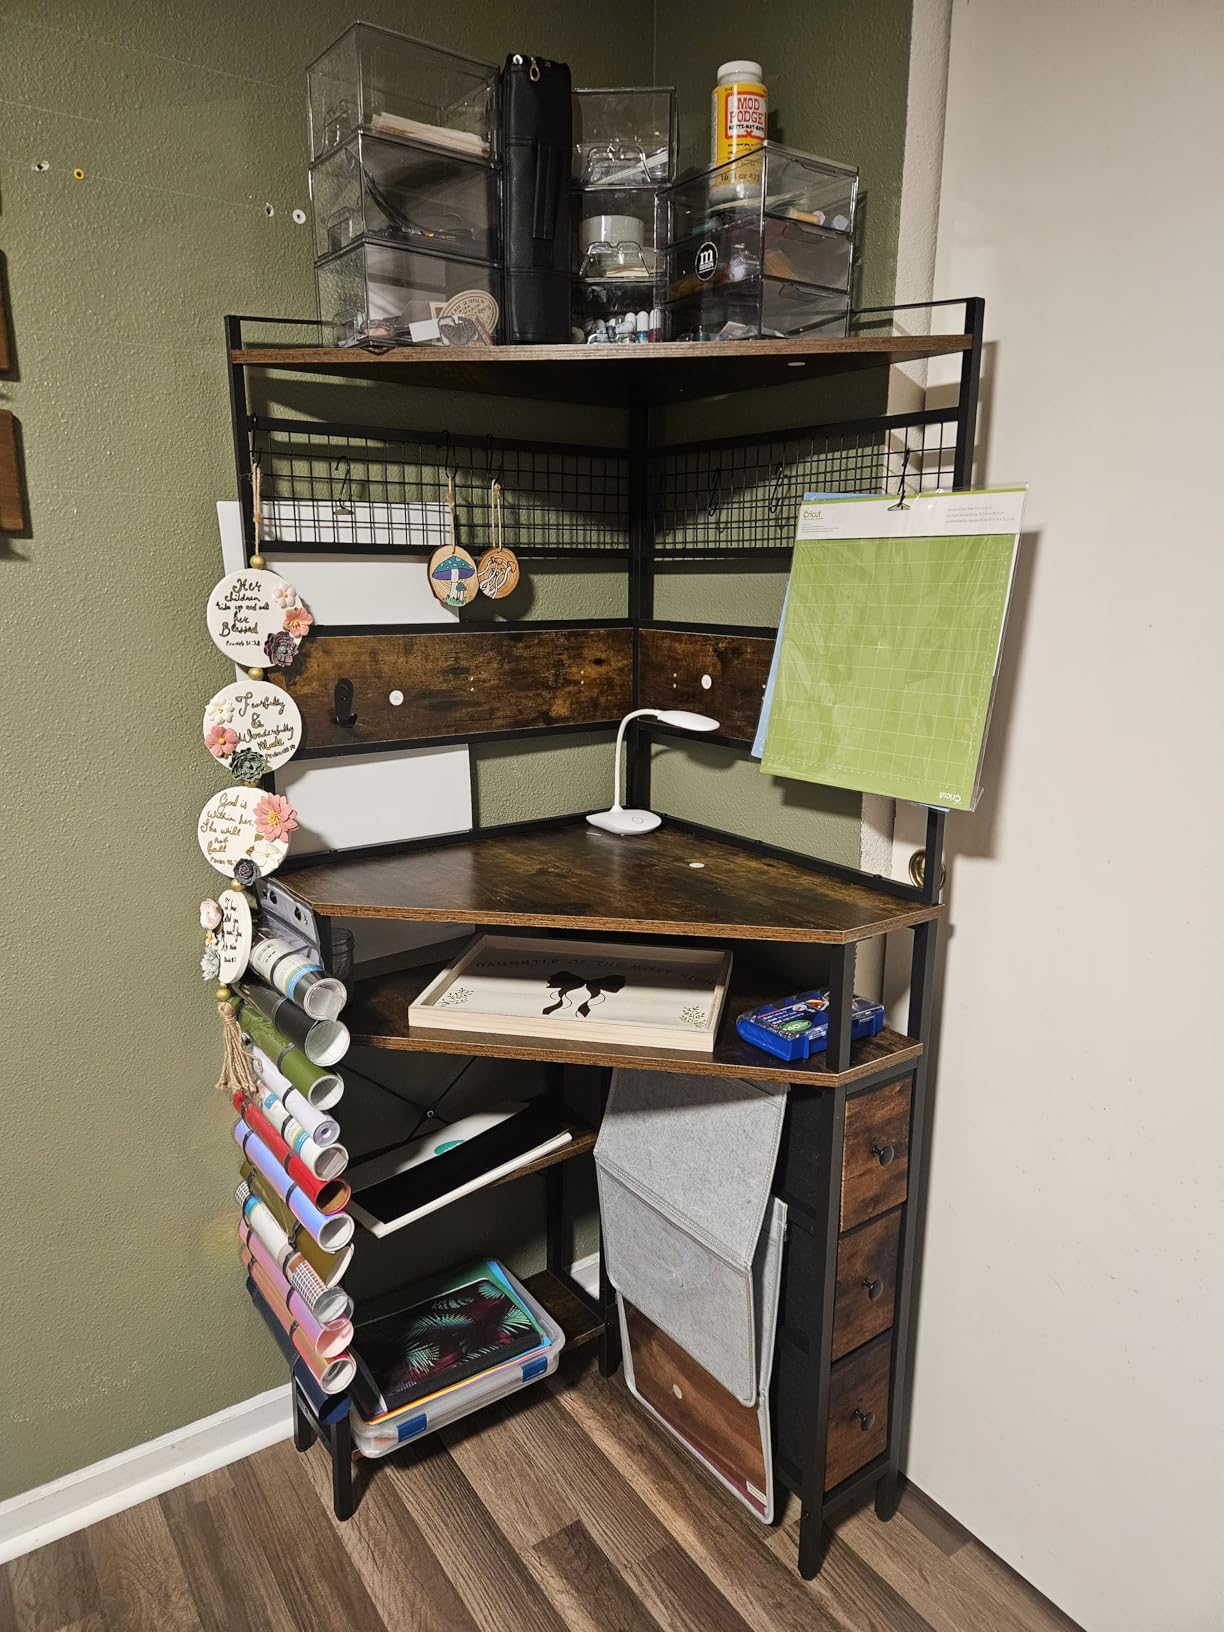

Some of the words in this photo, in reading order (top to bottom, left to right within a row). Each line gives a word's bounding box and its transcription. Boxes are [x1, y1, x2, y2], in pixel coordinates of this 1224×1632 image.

[737, 97, 760, 111] MOD
[232, 578, 261, 593] Her
[217, 792, 240, 814] God
[240, 800, 247, 809] is
